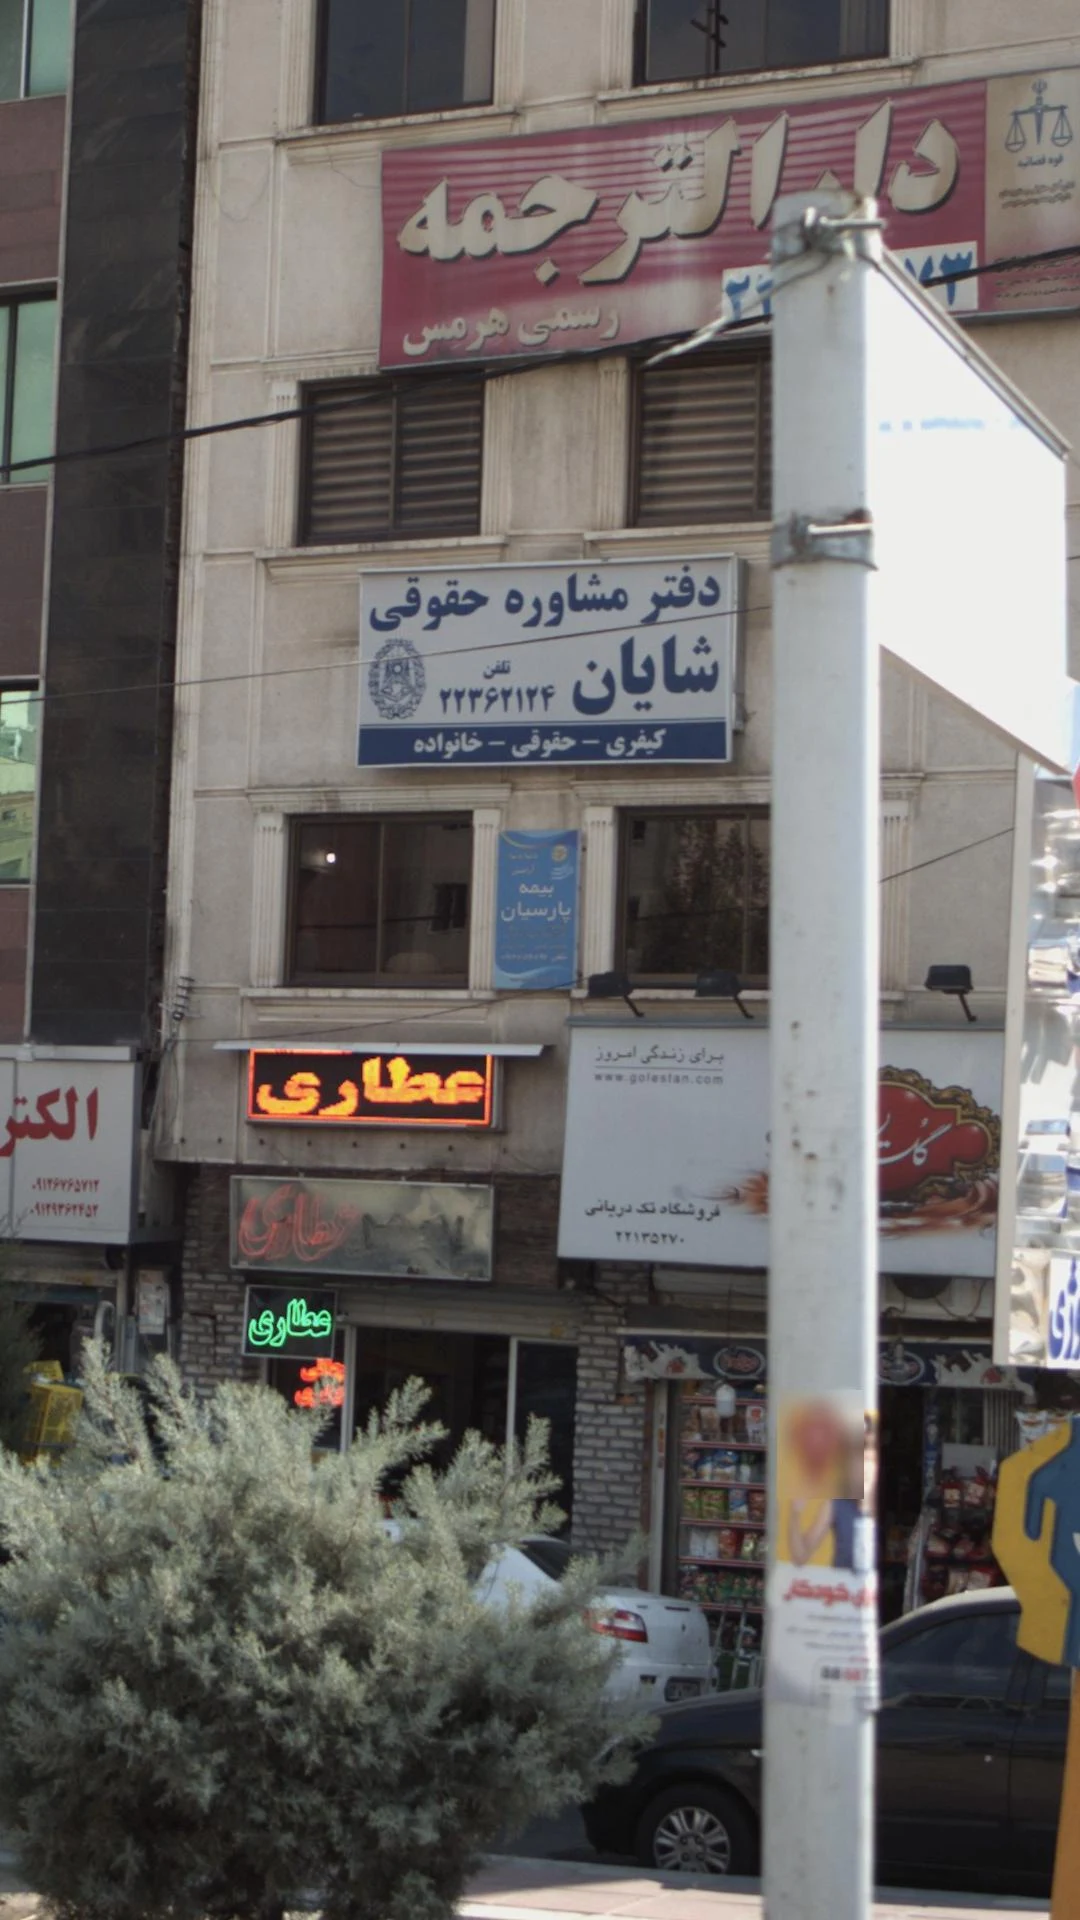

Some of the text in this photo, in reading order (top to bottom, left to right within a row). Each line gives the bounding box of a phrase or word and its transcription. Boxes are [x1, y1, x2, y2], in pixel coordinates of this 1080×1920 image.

[518, 305, 621, 346] رسمی
[369, 564, 721, 631] دفتر مشاوره حقوقی
[483, 660, 512, 679] تلفن
[572, 634, 720, 715] شایان
[439, 684, 556, 715] ۲۲۳۶۲۱۲۴
[414, 727, 667, 758] کیفری حقوقی خانواده
[519, 882, 554, 898] بیمه
[501, 901, 572, 923] پارسیان
[595, 1045, 725, 1064] برای زندگی امروز
[256, 1056, 485, 1116] عطاری
[594, 1072, 724, 1085] www.golestan.com
[636, 1201, 656, 1215] تک
[659, 1203, 721, 1222] فروشگاه
[248, 1298, 331, 1347] عطاری
